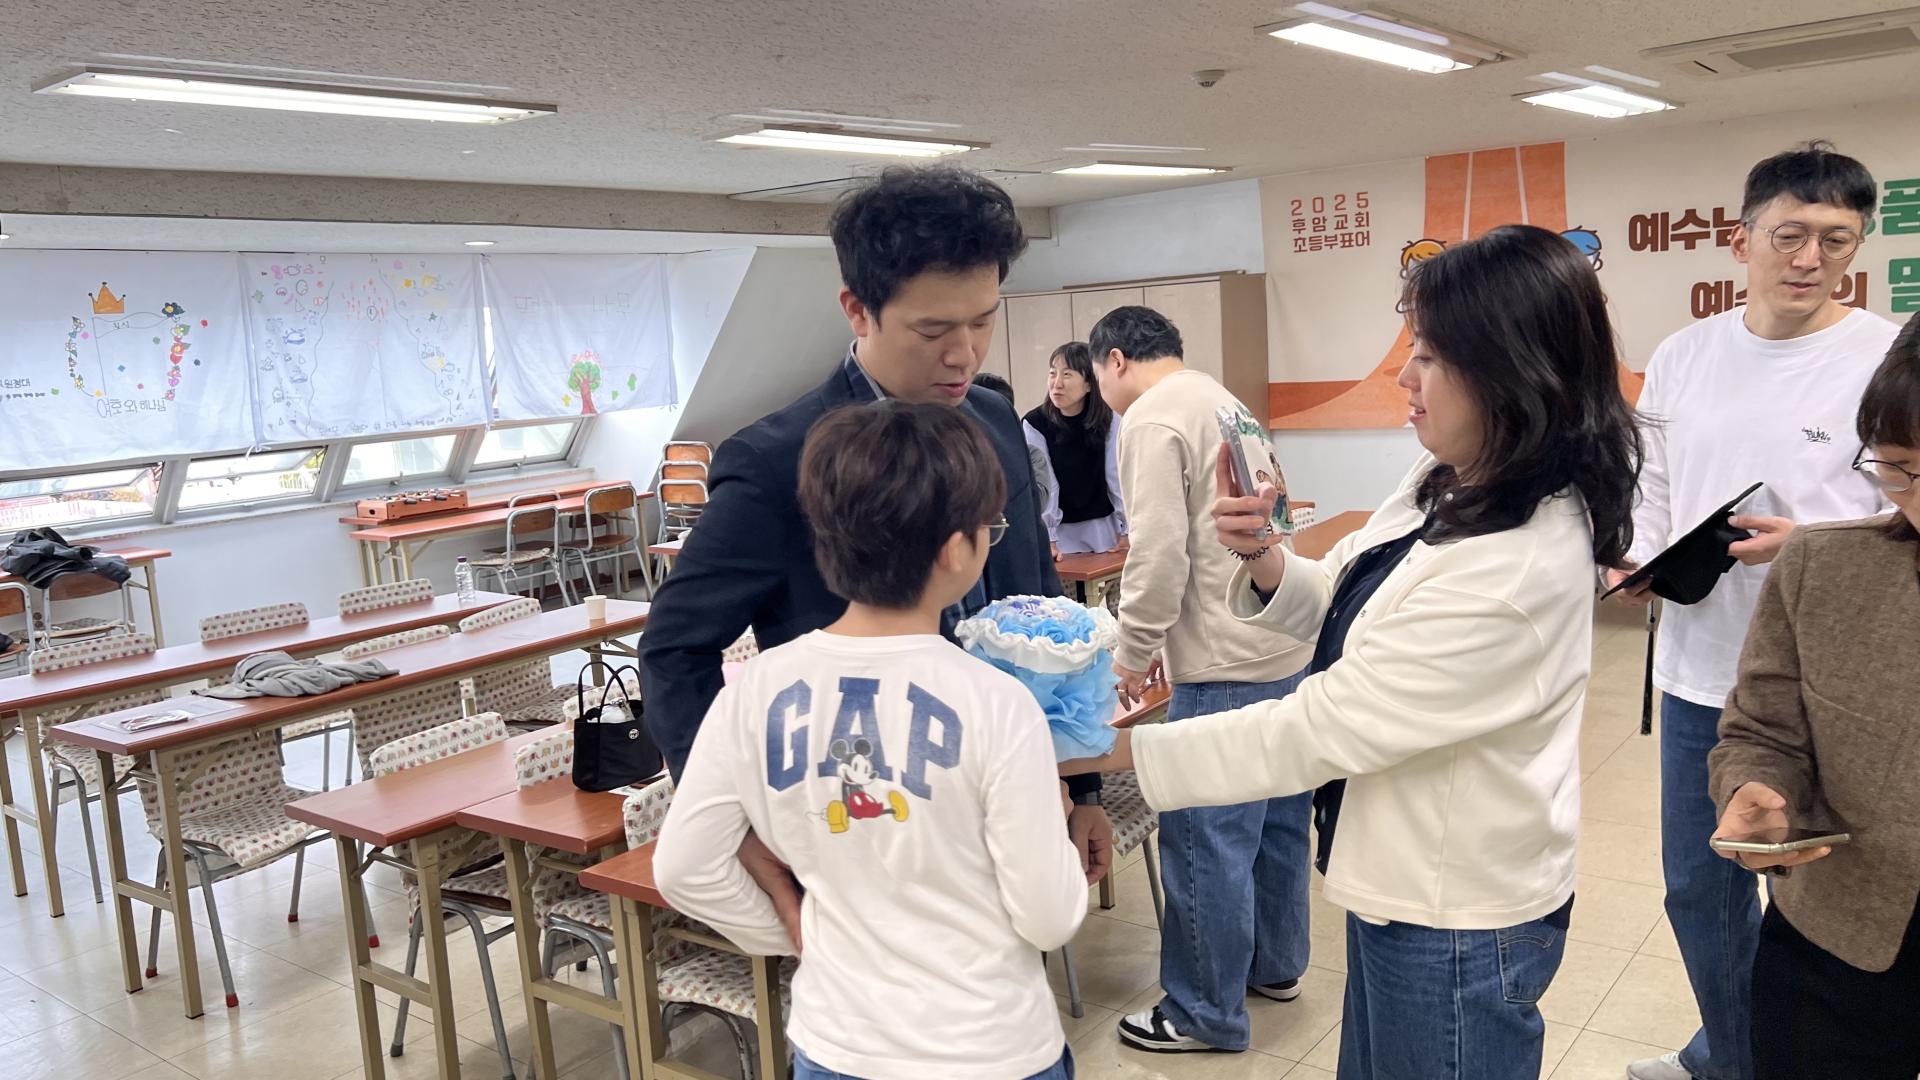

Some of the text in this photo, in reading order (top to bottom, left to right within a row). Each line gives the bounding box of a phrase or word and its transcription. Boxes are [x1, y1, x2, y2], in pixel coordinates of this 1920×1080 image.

[1290, 192, 1369, 216] 2025
[1292, 211, 1370, 234] 후암교회
[1293, 230, 1370, 253] 초등부표어
[0, 378, 31, 388] 원정대
[767, 676, 964, 800] GAP
